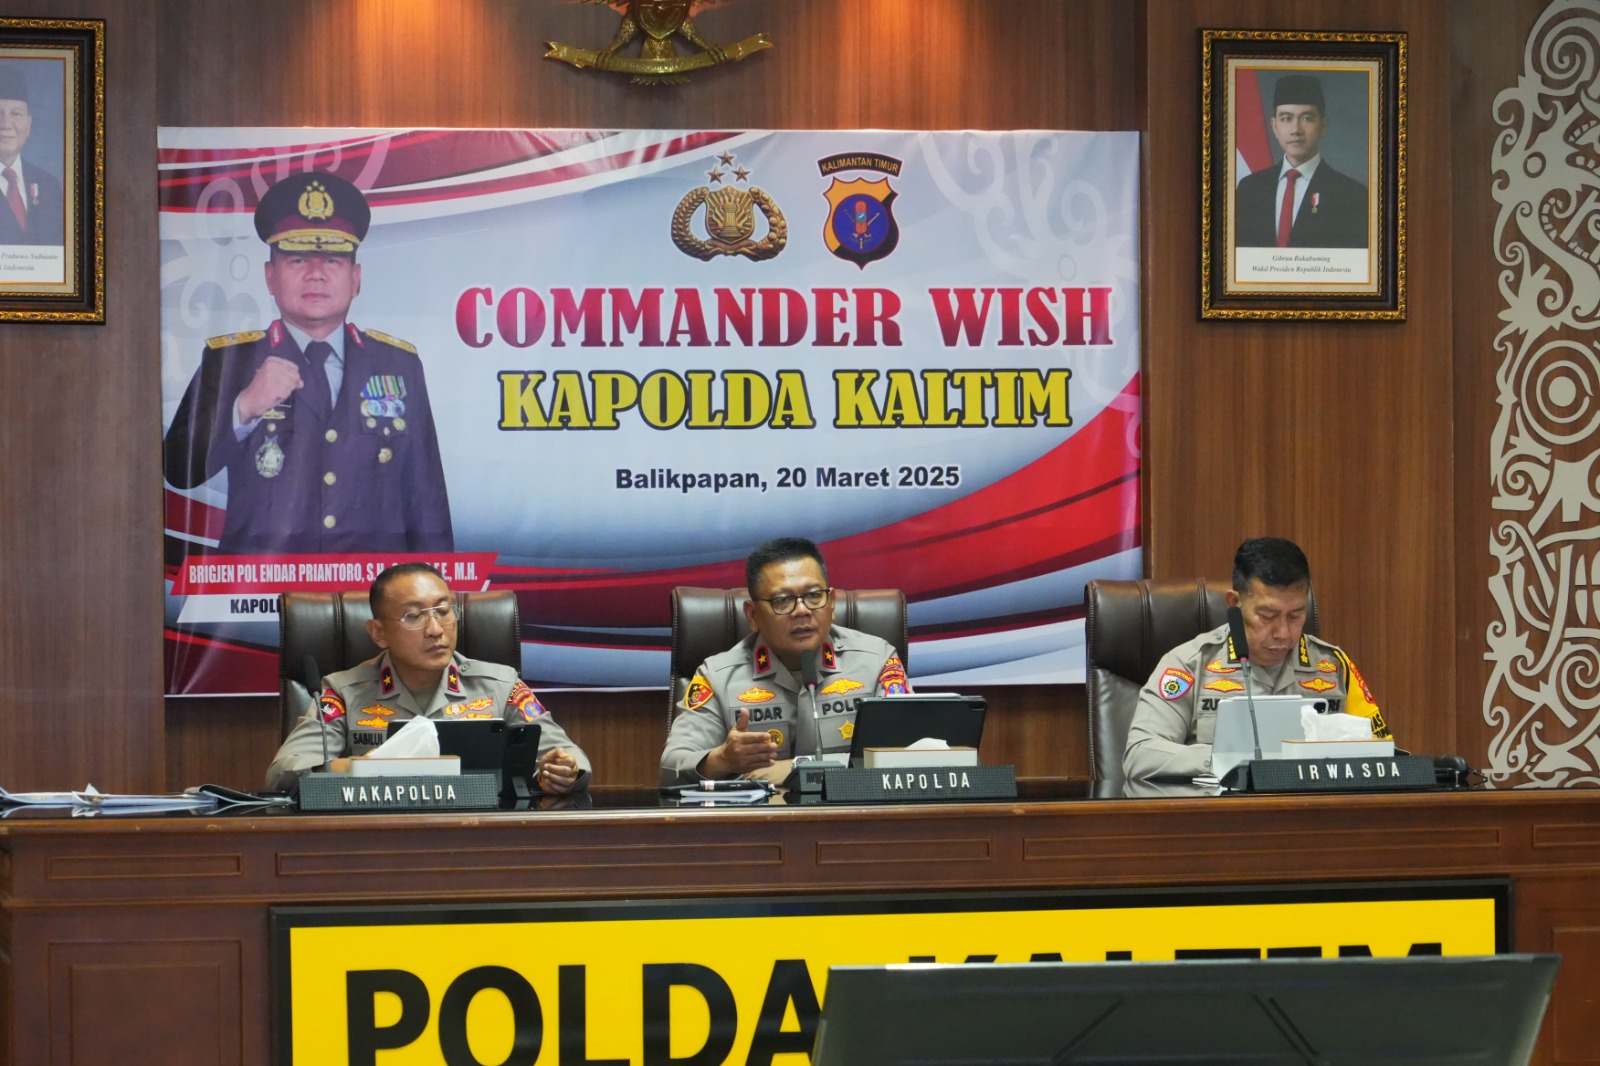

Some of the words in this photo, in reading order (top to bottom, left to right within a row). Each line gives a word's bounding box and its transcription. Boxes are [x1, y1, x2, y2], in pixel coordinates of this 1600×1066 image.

[821, 156, 873, 172] KALIMANTAN
[874, 158, 899, 173] TIMUR
[1, 252, 29, 260] Prabowo
[30, 252, 59, 260] Subianto
[3, 263, 35, 271] Indonesia
[1269, 265, 1295, 273] Presiden
[1296, 265, 1321, 274] Republik
[1322, 265, 1352, 273] Indonesia
[455, 286, 903, 348] COMMANDER
[928, 286, 1114, 347] WISH
[497, 369, 817, 431] KAPOLDA
[832, 368, 1073, 429] KALTIM
[615, 468, 767, 494] Balikpapan,
[776, 467, 807, 488] 20
[815, 466, 889, 488] Maret
[898, 465, 960, 488] 2025
[189, 564, 235, 583] BRIGJEN
[237, 564, 258, 582] POL
[260, 563, 297, 582] ENDAR
[298, 562, 365, 583] PRIANTORO,
[454, 561, 478, 581] M.H.
[230, 598, 281, 614] KAPOL
[1297, 761, 1401, 780] IRWASDA
[881, 772, 970, 790] KAPOLDA
[341, 784, 457, 802] WAKAPOLDA
[345, 958, 824, 1066] POLDA
